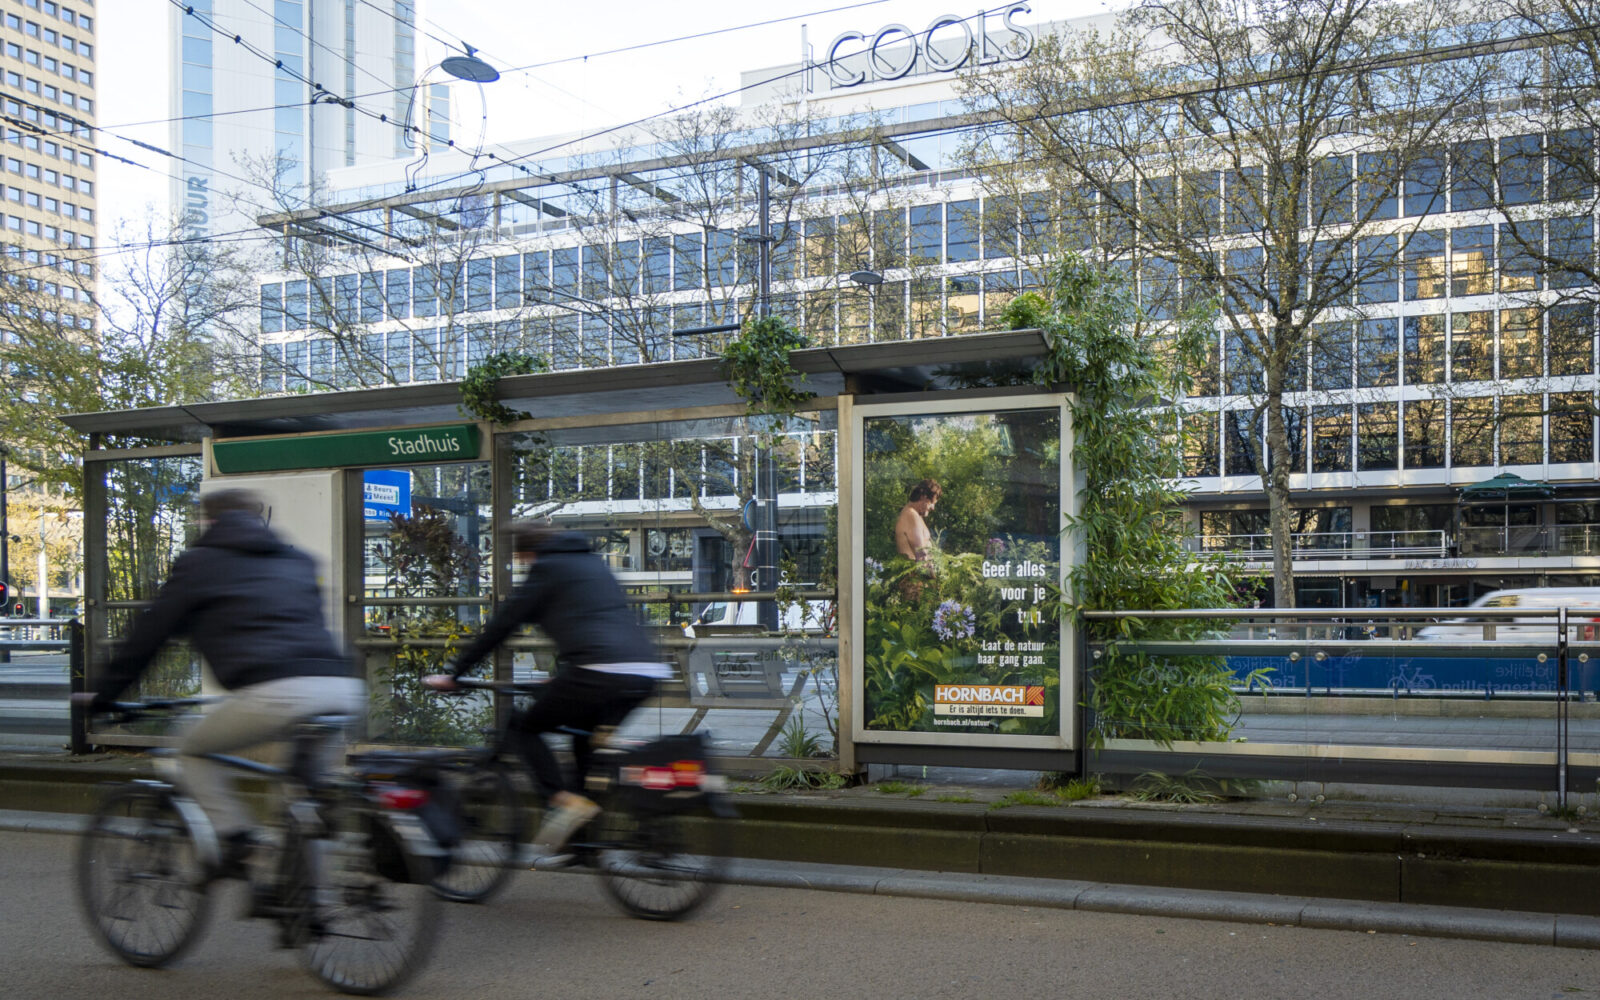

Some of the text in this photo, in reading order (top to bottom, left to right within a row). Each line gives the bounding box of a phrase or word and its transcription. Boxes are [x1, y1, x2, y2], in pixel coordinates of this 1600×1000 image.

[388, 433, 460, 455] Stadhuis
[374, 485, 393, 494] Beurs
[374, 493, 394, 502] Meent
[982, 561, 1046, 577] Geef alles
[1001, 584, 1046, 604] voor je
[982, 640, 1045, 652] Laat de natuur
[977, 653, 1045, 667] haar gang gaan.
[936, 687, 1024, 703] HORNBACH
[949, 705, 957, 713] Er
[958, 705, 965, 714] is
[966, 705, 984, 716] altijd
[1000, 707, 1008, 715] te
[1009, 707, 1027, 715] doen.
